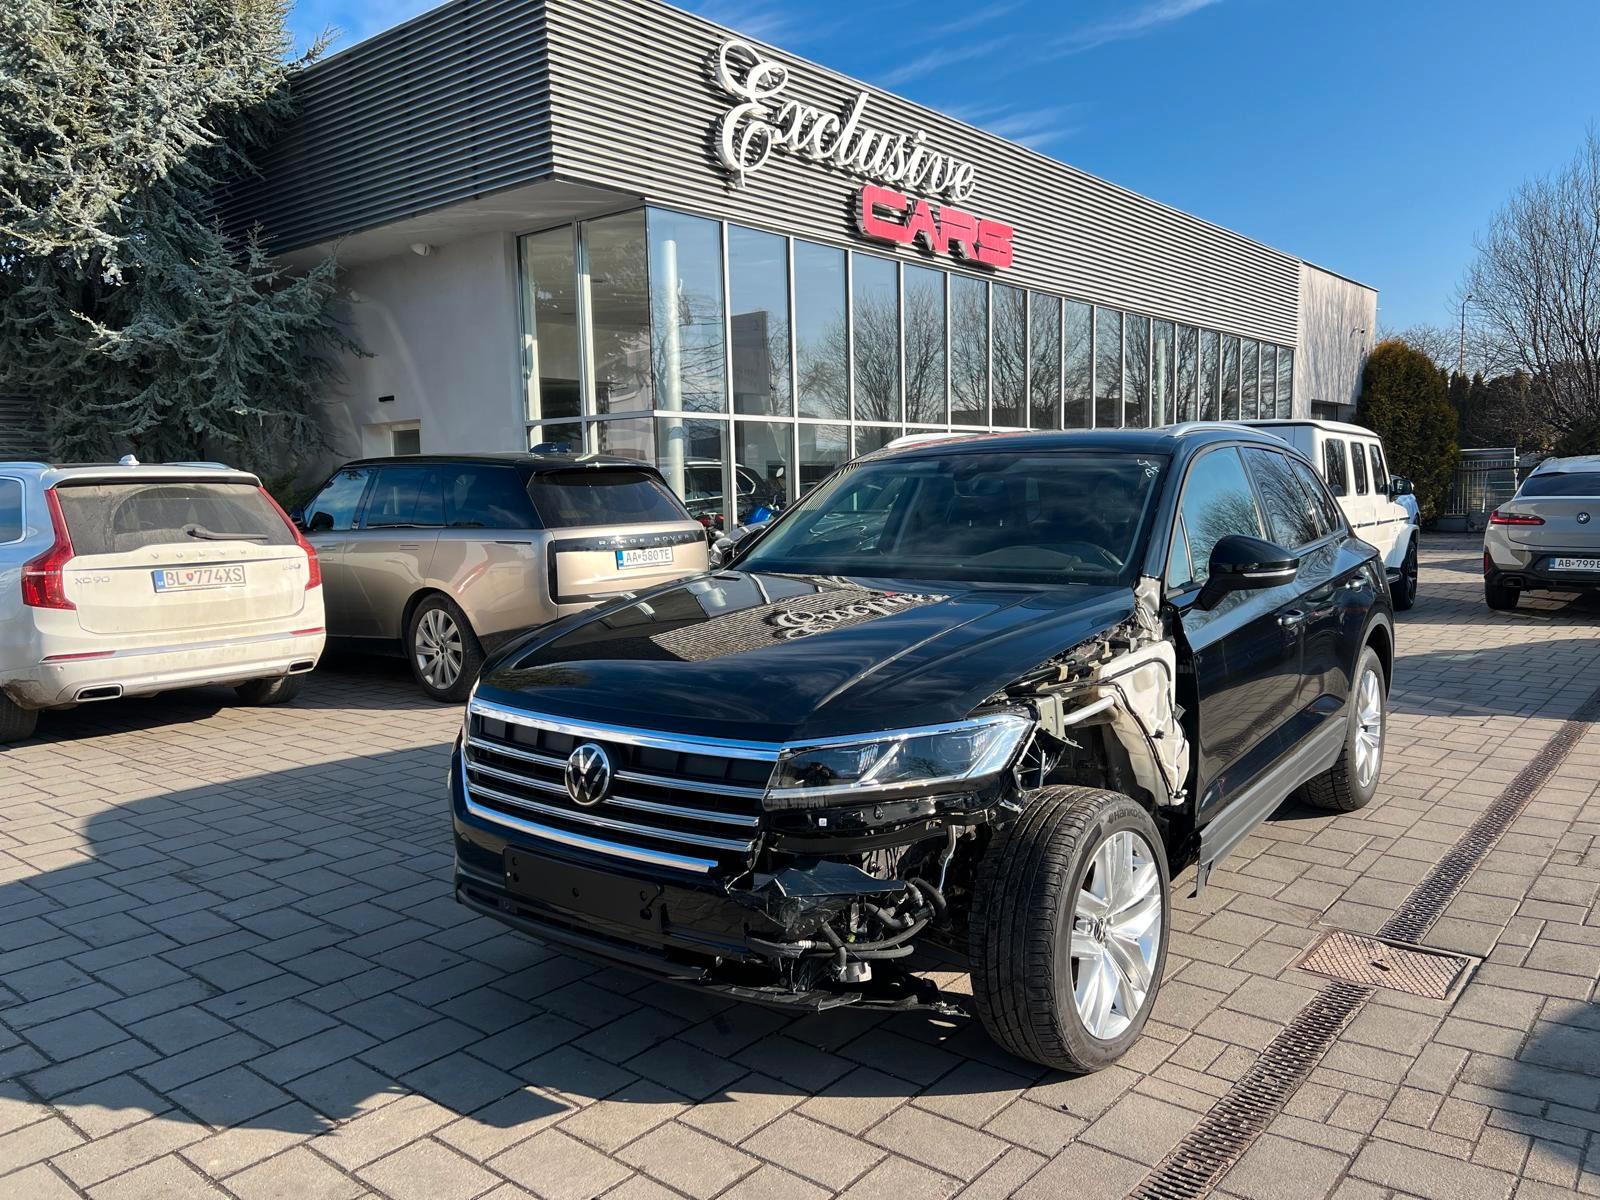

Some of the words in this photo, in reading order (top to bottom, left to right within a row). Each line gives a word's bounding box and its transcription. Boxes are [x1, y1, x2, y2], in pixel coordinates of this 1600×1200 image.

[716, 39, 976, 201] Exclusive
[857, 184, 1014, 269] CARS
[598, 537, 645, 546] RANGE
[654, 534, 689, 542] ROVER
[74, 577, 111, 585] XC90
